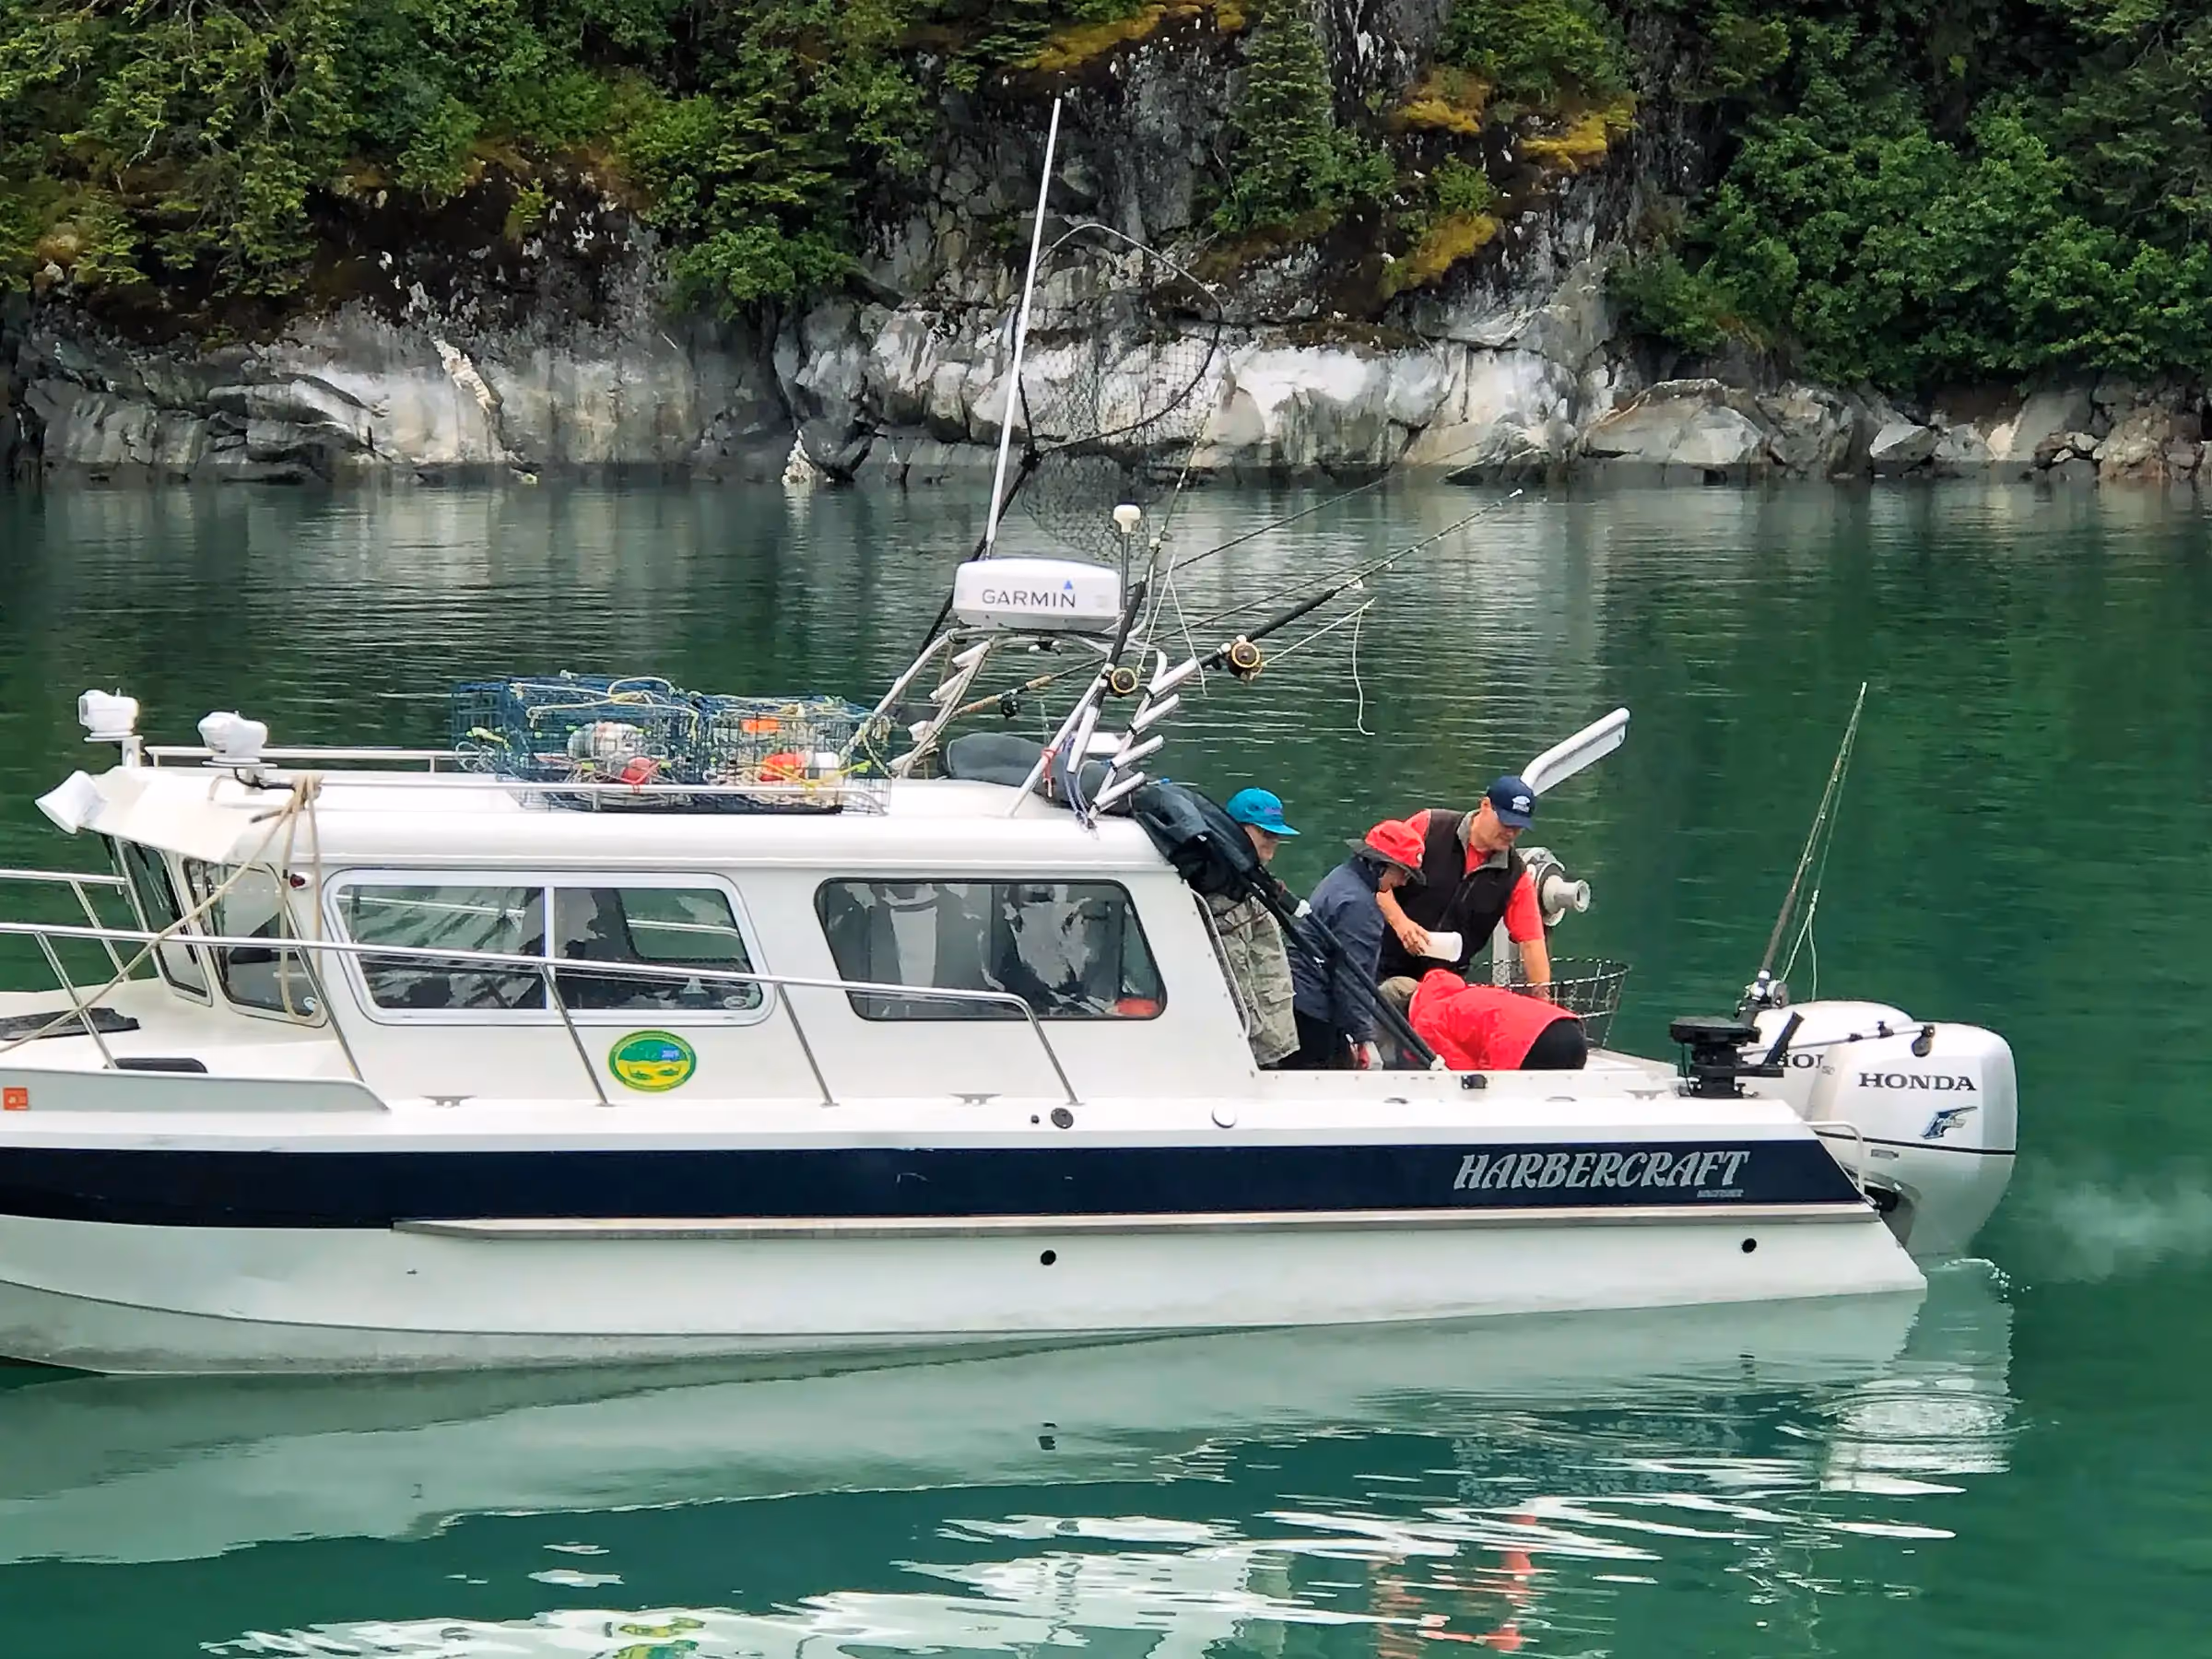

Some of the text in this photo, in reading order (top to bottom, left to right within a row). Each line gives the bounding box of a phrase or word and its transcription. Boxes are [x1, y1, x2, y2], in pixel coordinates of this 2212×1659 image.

[982, 589, 1076, 608] GARMIN
[1858, 1073, 1977, 1091] HONDA
[1453, 1151, 1750, 1189] HARBERCRAFT
